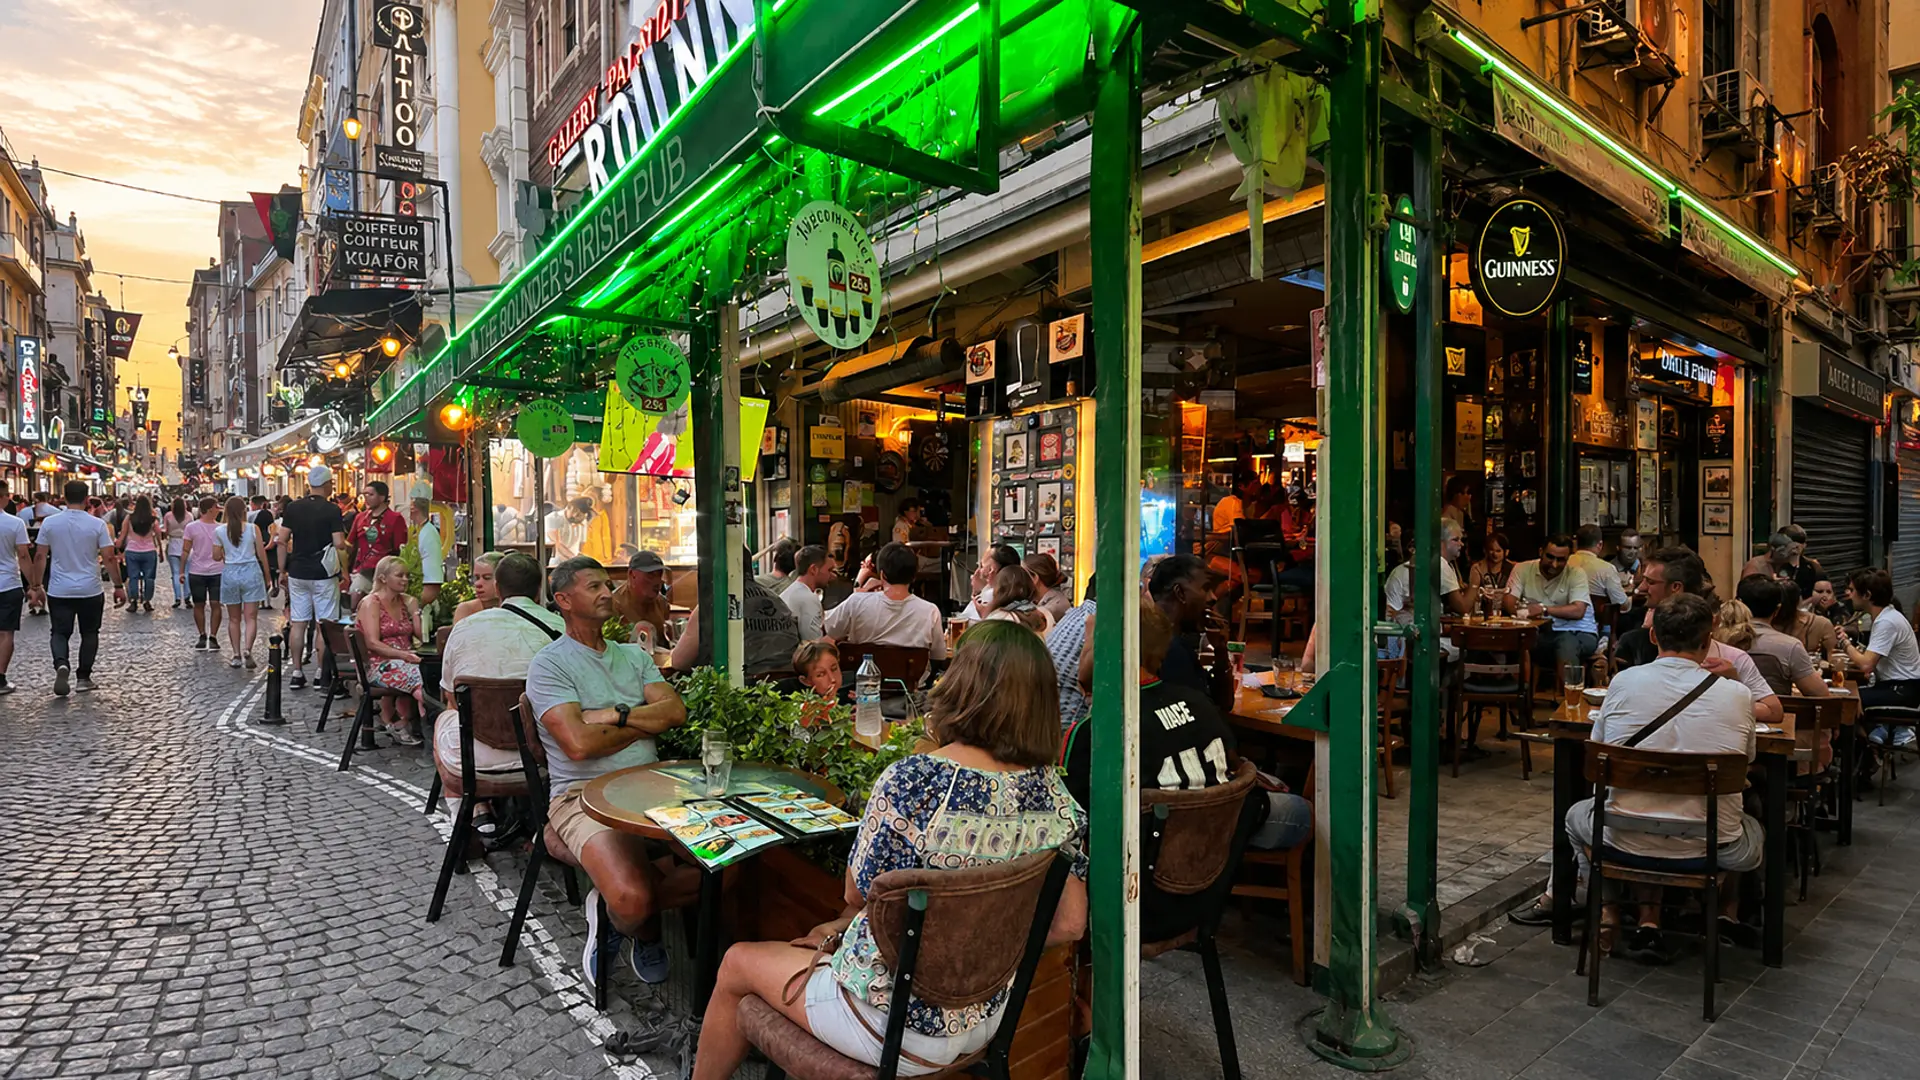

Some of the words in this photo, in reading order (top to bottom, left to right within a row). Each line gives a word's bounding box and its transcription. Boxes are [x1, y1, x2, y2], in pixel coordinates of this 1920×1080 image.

[548, 86, 599, 166] GALERY
[500, 243, 574, 337] BOUNDER'S
[577, 188, 628, 275] IRISH
[633, 135, 685, 223] PUB
[1484, 259, 1555, 279] GUINNESS
